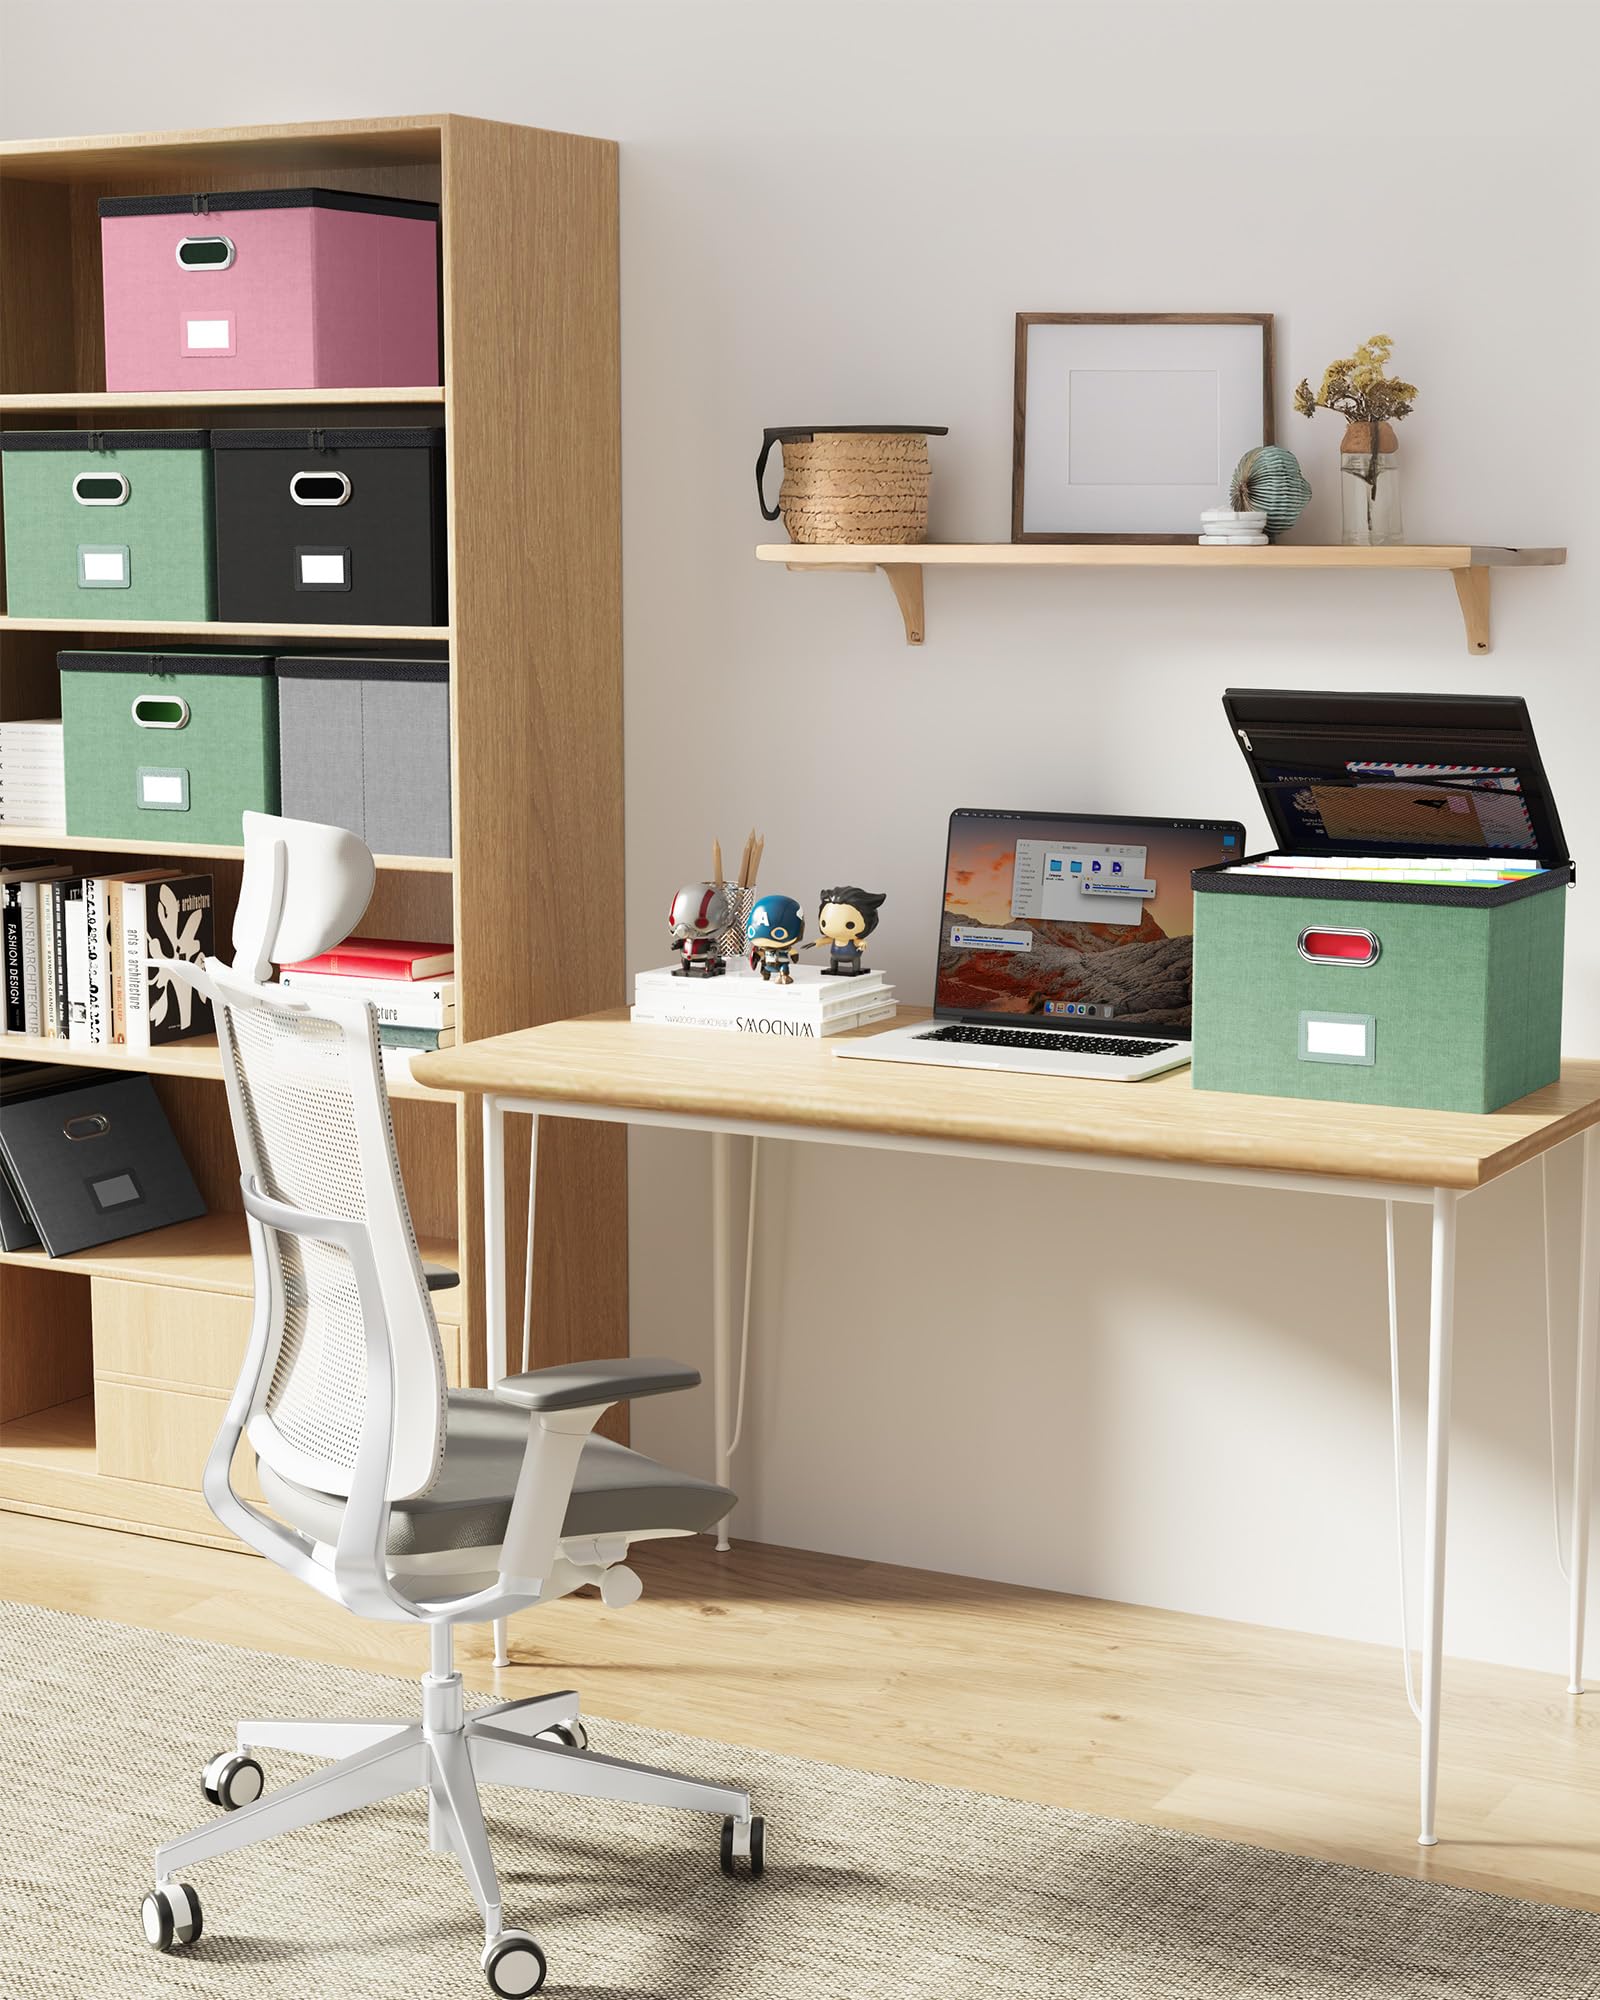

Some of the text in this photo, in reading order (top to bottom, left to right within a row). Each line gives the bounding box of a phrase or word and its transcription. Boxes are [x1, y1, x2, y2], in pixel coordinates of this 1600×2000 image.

[757, 907, 770, 927] A
[127, 929, 138, 946] arts
[7, 923, 20, 1005] FASHION DESIGN
[23, 906, 39, 1034] INNENARCHITEKTUR
[129, 959, 141, 1010] architecture
[735, 1016, 814, 1038] WINDOWS
